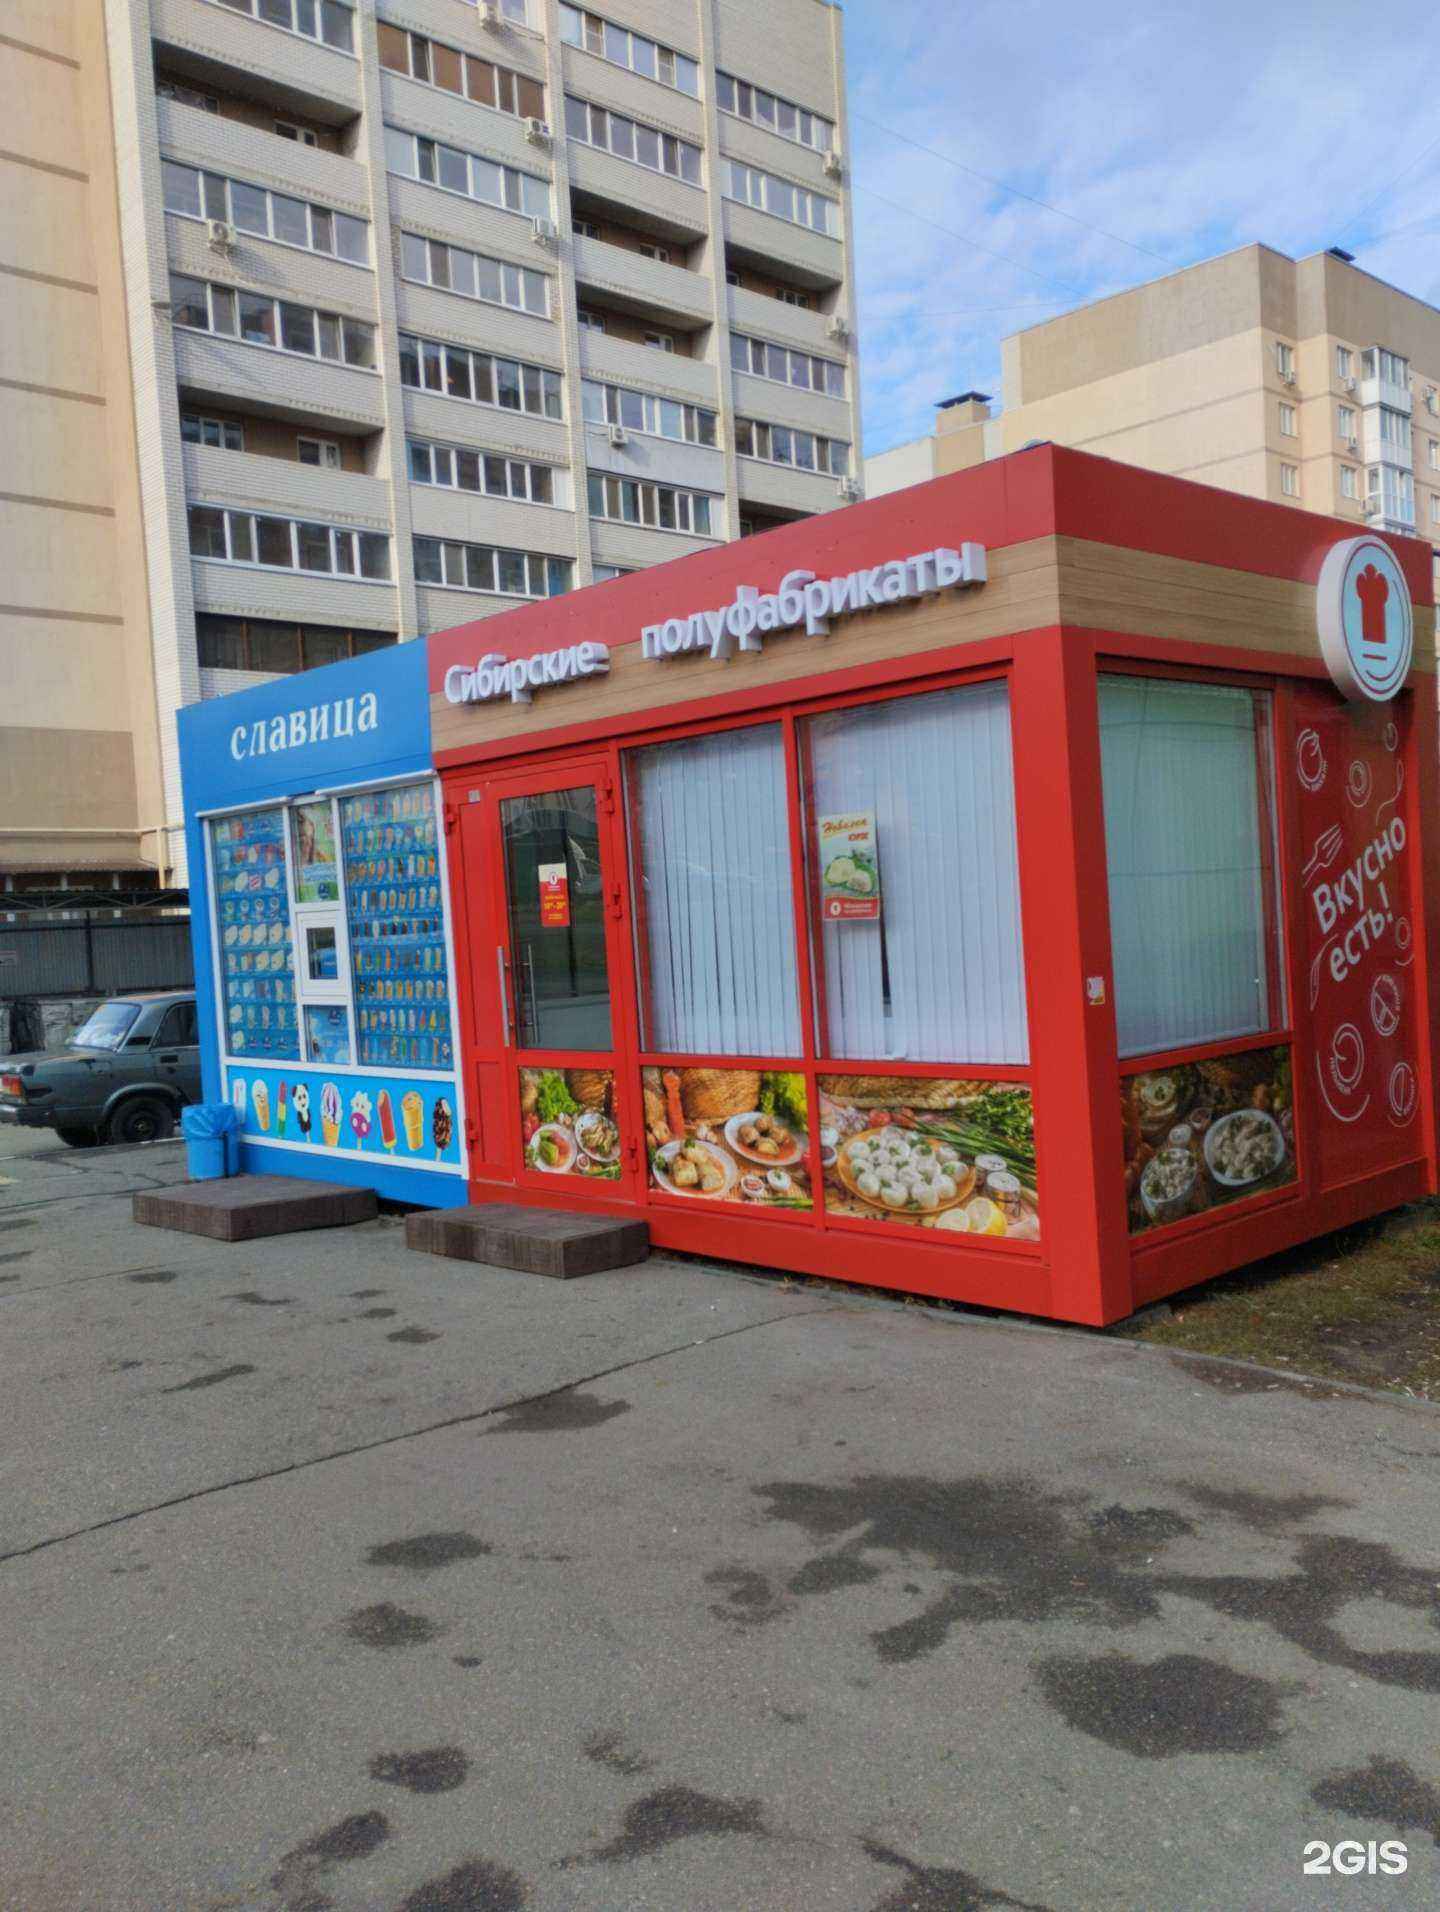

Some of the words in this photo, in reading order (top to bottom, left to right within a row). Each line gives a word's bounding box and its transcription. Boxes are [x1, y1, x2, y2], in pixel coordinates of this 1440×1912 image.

[444, 641, 609, 703] Сибирские
[641, 542, 987, 659] полуфабрикаты
[230, 691, 378, 761] славица
[1312, 816, 1407, 935] Вкусно
[1329, 880, 1394, 983] есть!
